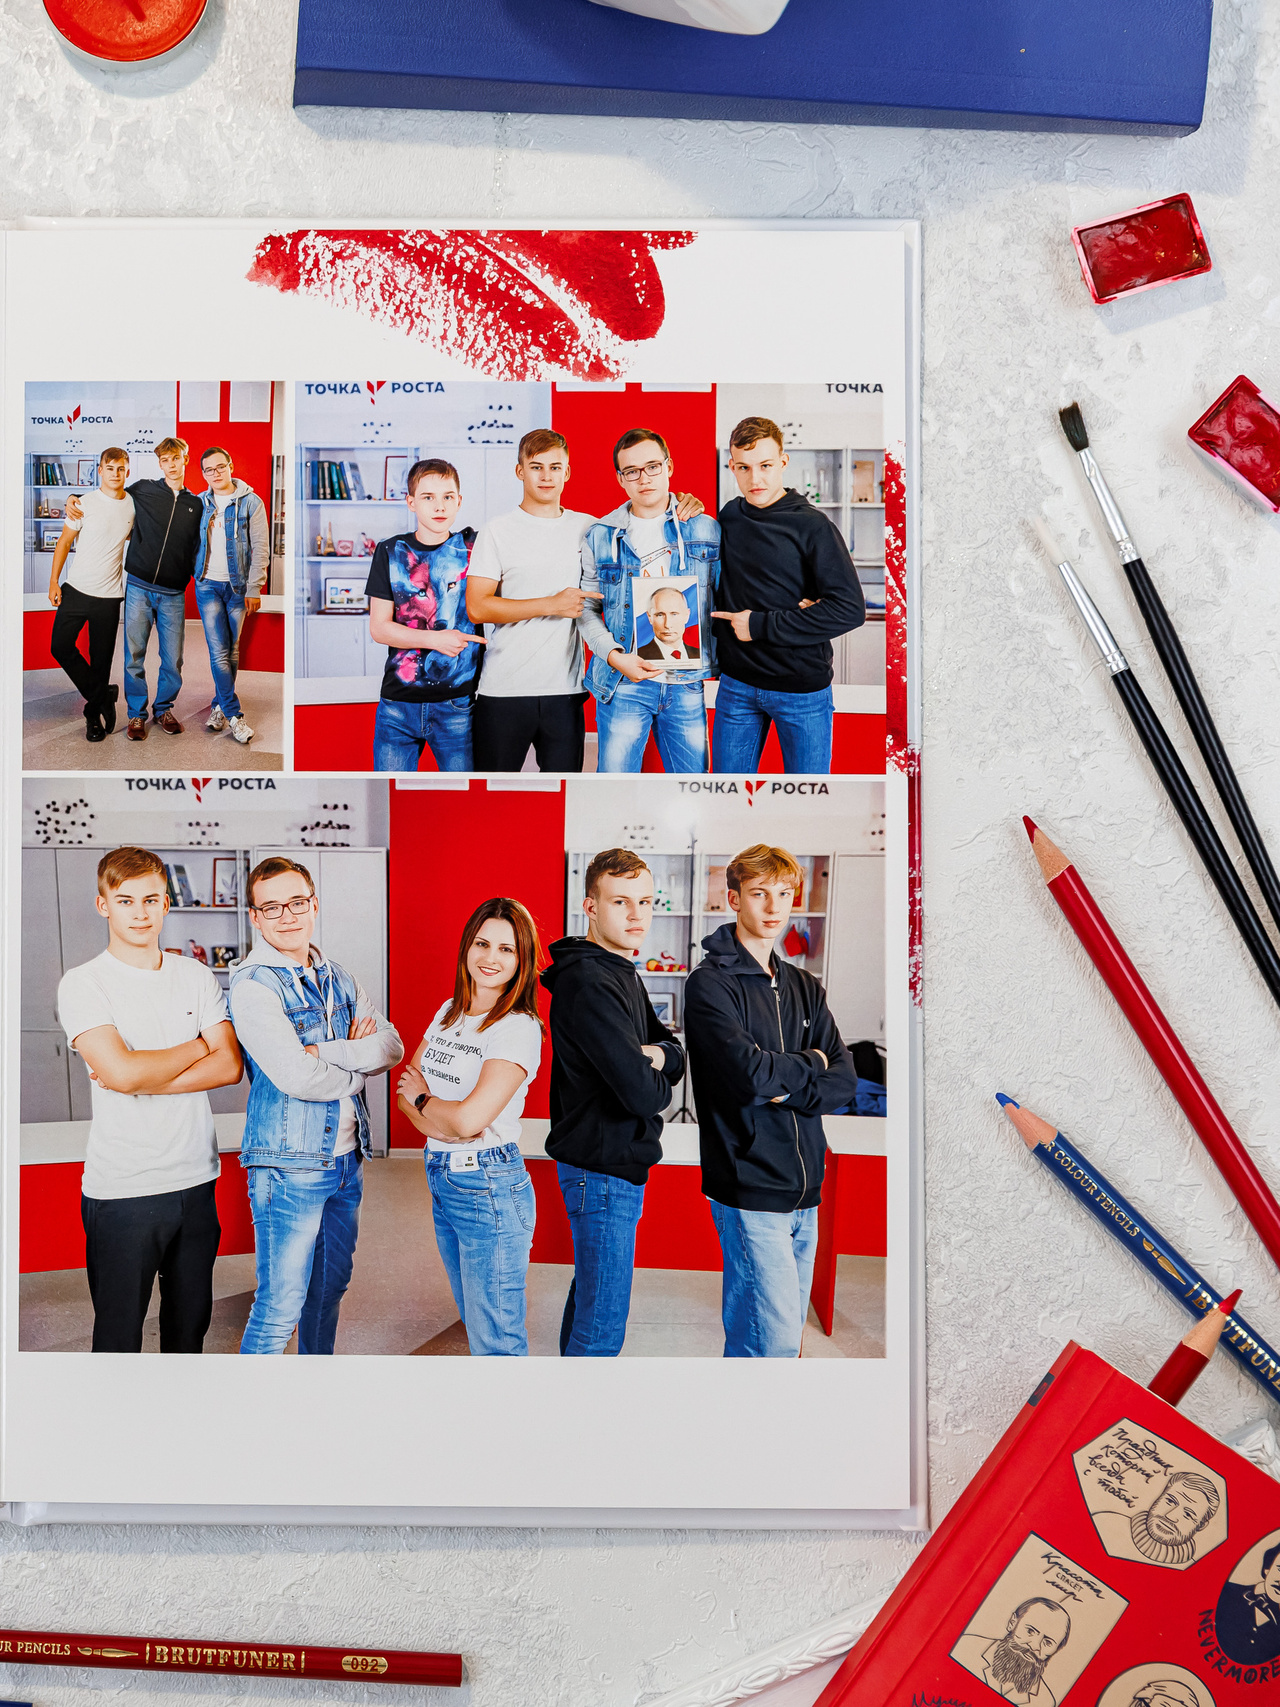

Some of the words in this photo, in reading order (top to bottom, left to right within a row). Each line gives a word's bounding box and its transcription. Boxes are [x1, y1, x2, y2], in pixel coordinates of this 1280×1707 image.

[305, 383, 361, 395] ТОЧКА
[391, 382, 445, 394] РОСТА
[825, 383, 884, 393] ТОЧКА
[31, 416, 65, 425] ТОЧКА
[81, 416, 114, 424] РОСТА
[125, 778, 186, 790] ТОЧКА
[218, 778, 277, 790] РОСТА
[678, 781, 739, 794] ТОЧКА
[771, 782, 829, 795] РОСТА
[424, 1047, 455, 1065] БУДЕТ
[1054, 1149, 1098, 1195] COLOUR
[1095, 1191, 1141, 1237] PENCILS
[1088, 1454, 1125, 1485] всегда
[1097, 1478, 1139, 1508] тобой
[1041, 1552, 1105, 1599] Красота
[1056, 1572, 1084, 1592] СПАСЕТ
[16, 1642, 71, 1656] PENCILS
[1197, 1609, 1280, 1684] NEVERMORE
[154, 1645, 296, 1671] BRUTFUNER
[350, 1657, 379, 1671] 092
